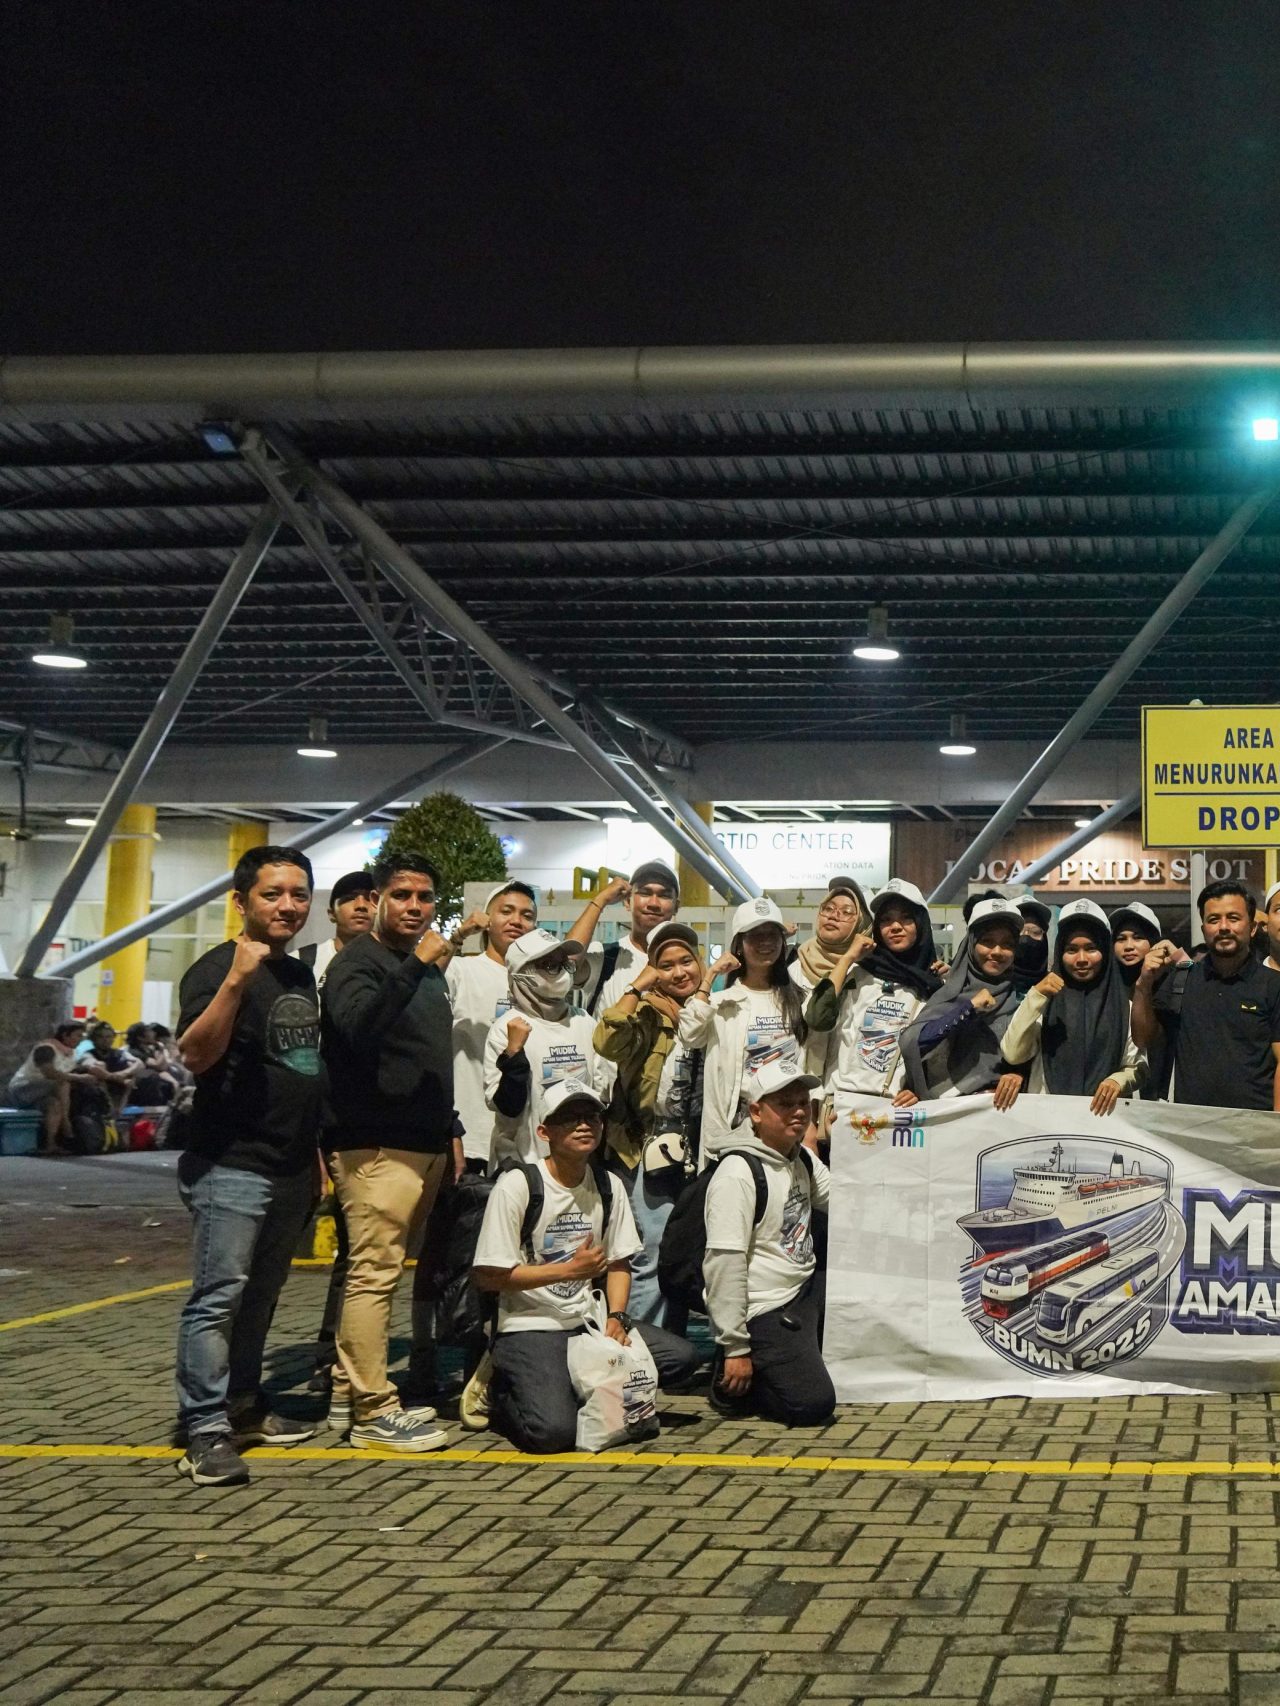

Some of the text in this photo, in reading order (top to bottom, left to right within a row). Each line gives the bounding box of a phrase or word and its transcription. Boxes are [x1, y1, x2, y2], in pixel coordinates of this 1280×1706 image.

[1224, 728, 1274, 748] AREA
[1198, 806, 1280, 831] DROP
[772, 832, 854, 850] CENTER
[852, 862, 874, 870] DATA
[1061, 859, 1160, 881] PRIDE
[1170, 859, 1252, 881] SOT
[877, 999, 905, 1010] MUDIK
[550, 1047, 576, 1056] MUDIK
[557, 1213, 582, 1223] MUDIK
[993, 1310, 1152, 1371] BUMN 2025
